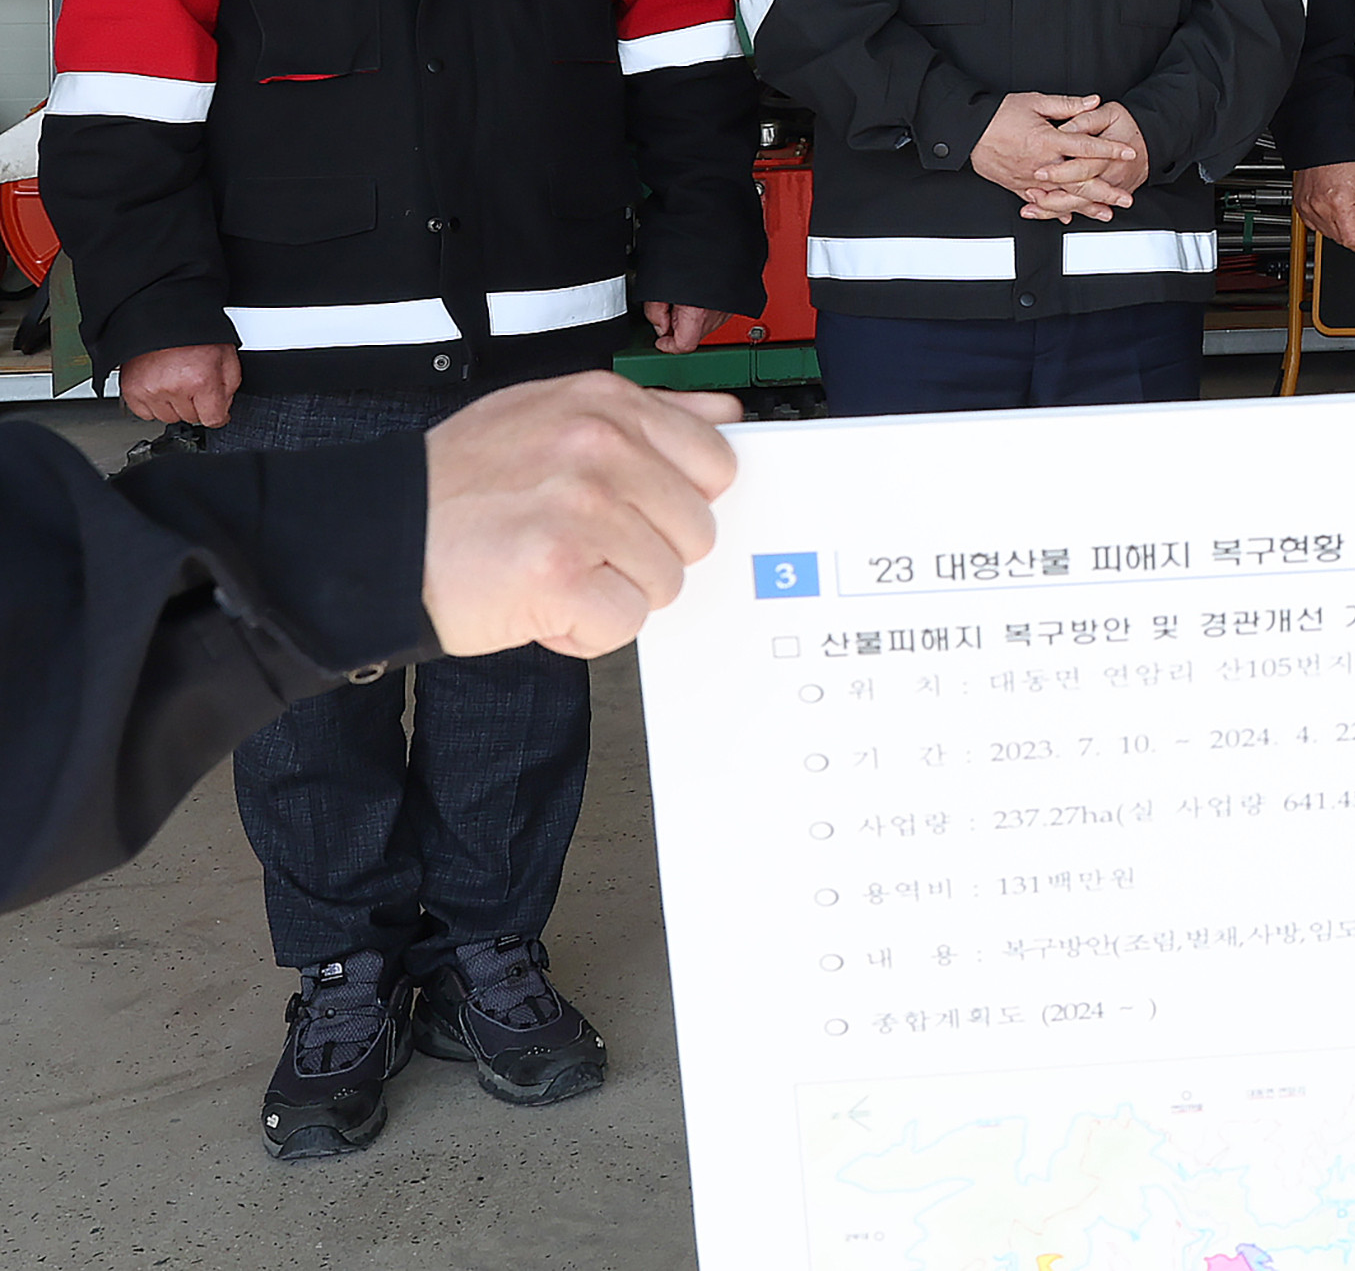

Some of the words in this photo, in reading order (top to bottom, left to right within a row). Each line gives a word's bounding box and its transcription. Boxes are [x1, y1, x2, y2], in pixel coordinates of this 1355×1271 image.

[775, 562, 798, 589] 3
[936, 547, 1071, 582] 대형산불
[1092, 541, 1190, 572] 피해지
[1212, 532, 1342, 566] 복구현황
[821, 624, 982, 658] 산불피해지
[1004, 616, 1131, 647] 복구방안
[1152, 614, 1178, 641] 및
[1202, 605, 1323, 637] 경관개선
[990, 666, 1081, 694] 대동면
[1104, 660, 1194, 687] 연암리
[1218, 652, 1352, 682] 산105번지
[990, 740, 1060, 763] 2023.
[1078, 738, 1100, 757] 7.
[1122, 735, 1156, 755] 10.
[1209, 727, 1278, 750] 2024.
[1296, 724, 1318, 745] 4.
[861, 811, 950, 838] 사업량
[1176, 794, 1264, 821] 사업량
[864, 878, 952, 905] 용역비
[872, 1006, 1026, 1034] 종합계획도
